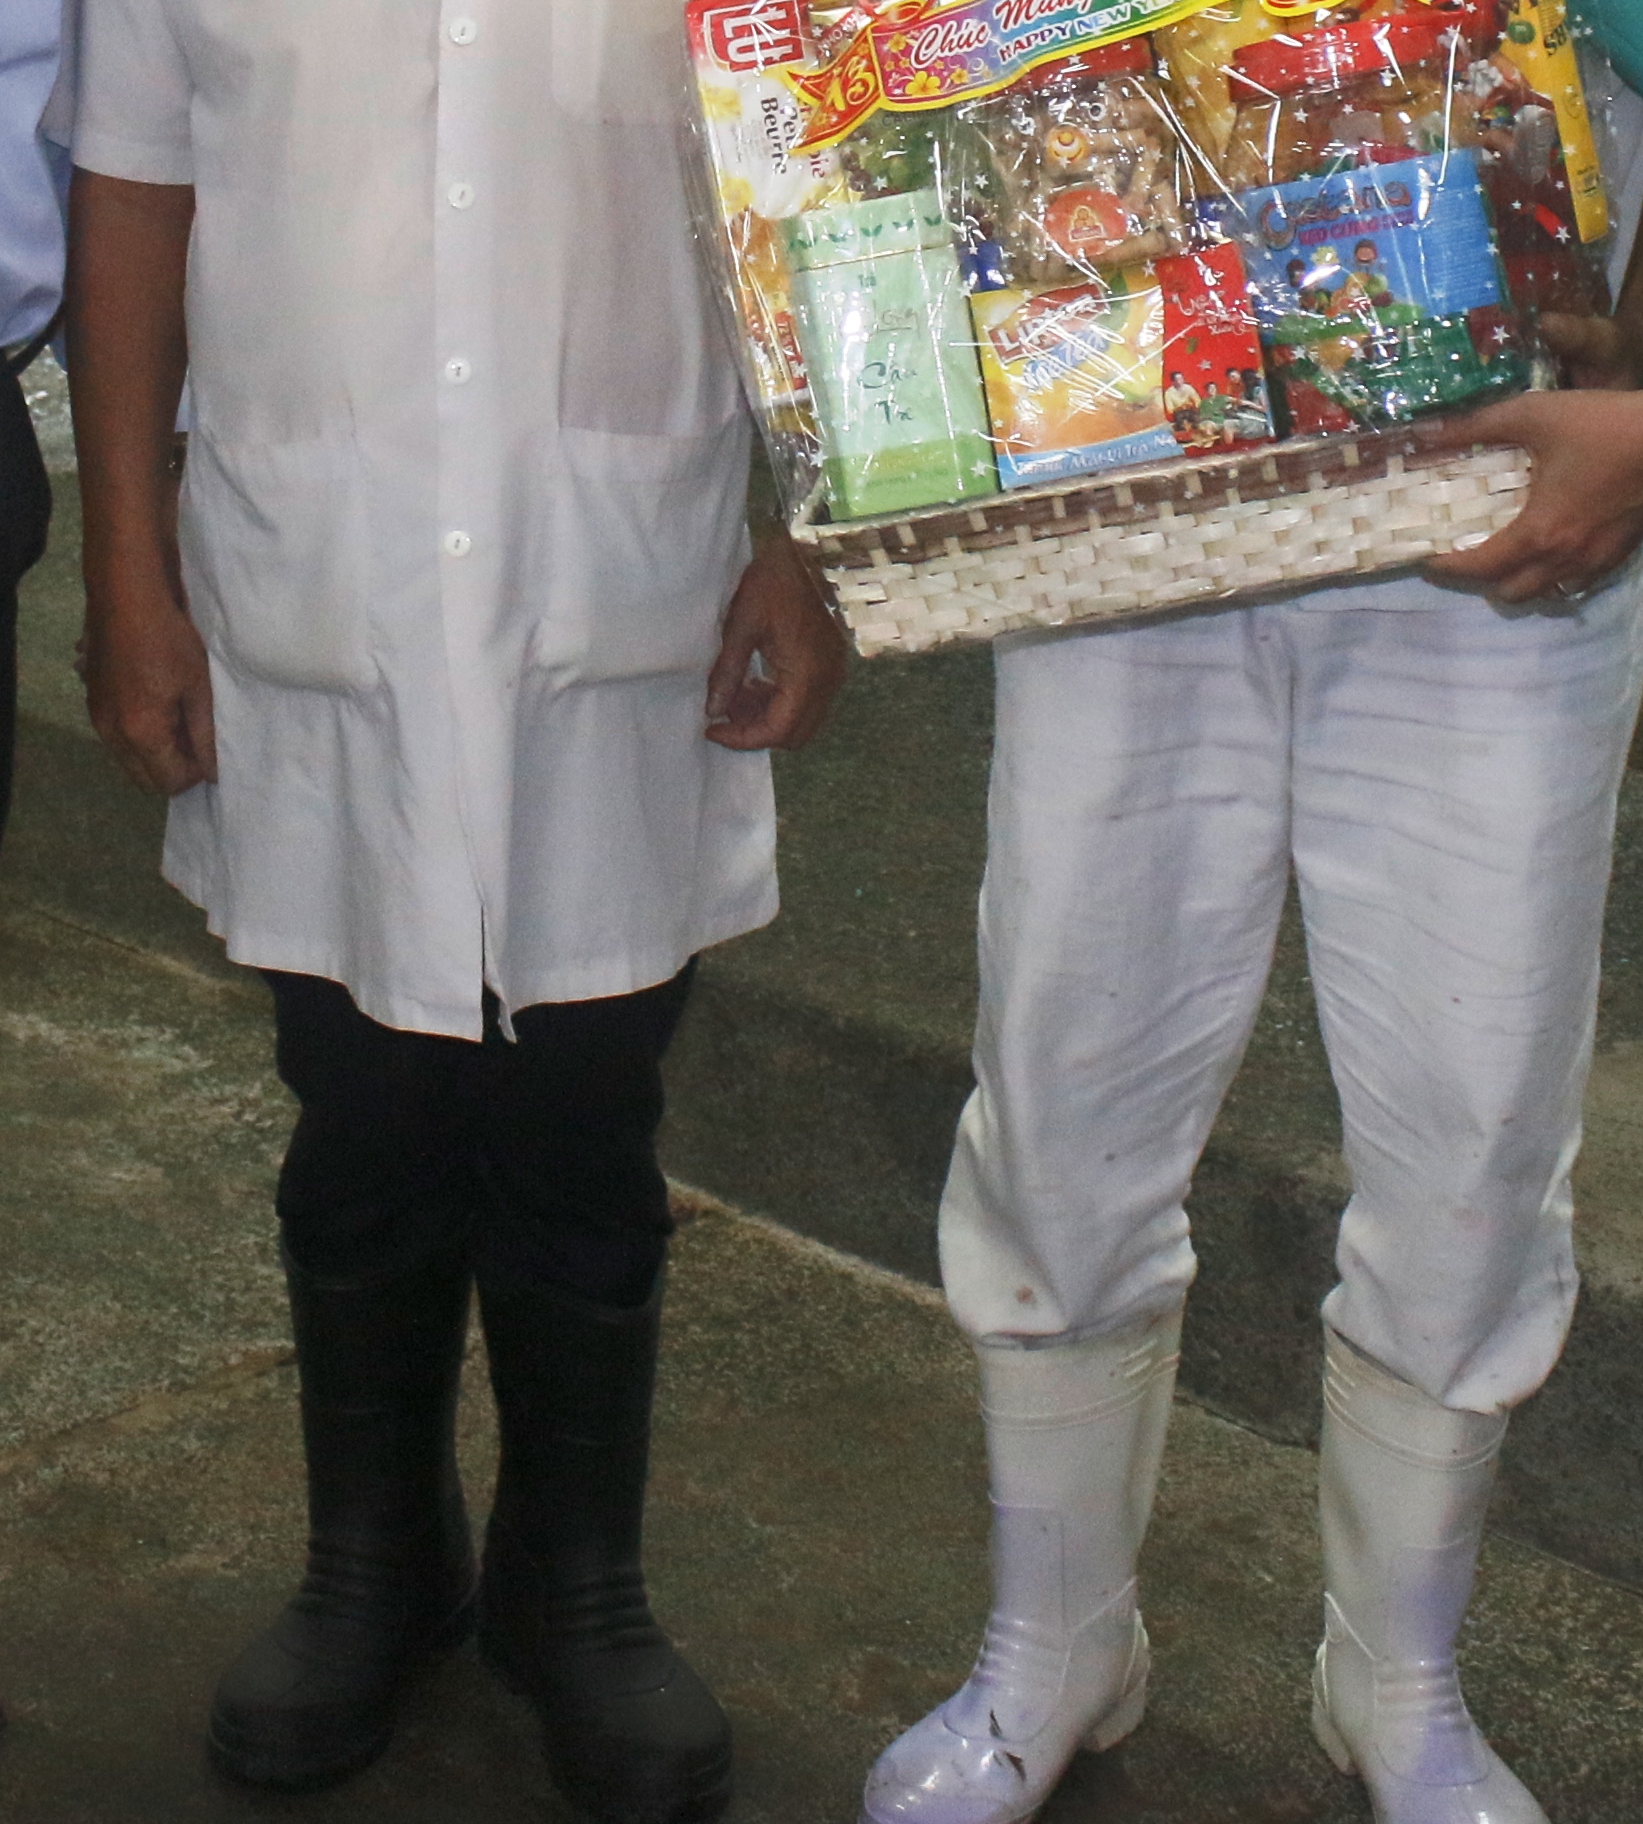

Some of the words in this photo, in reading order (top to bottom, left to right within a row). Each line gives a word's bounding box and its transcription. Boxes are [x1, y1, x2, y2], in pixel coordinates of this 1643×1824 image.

[723, 6, 793, 64] LU
[912, 19, 989, 65] Chúc
[999, 25, 1071, 64] HAPPY
[1077, 6, 1132, 33] NEW
